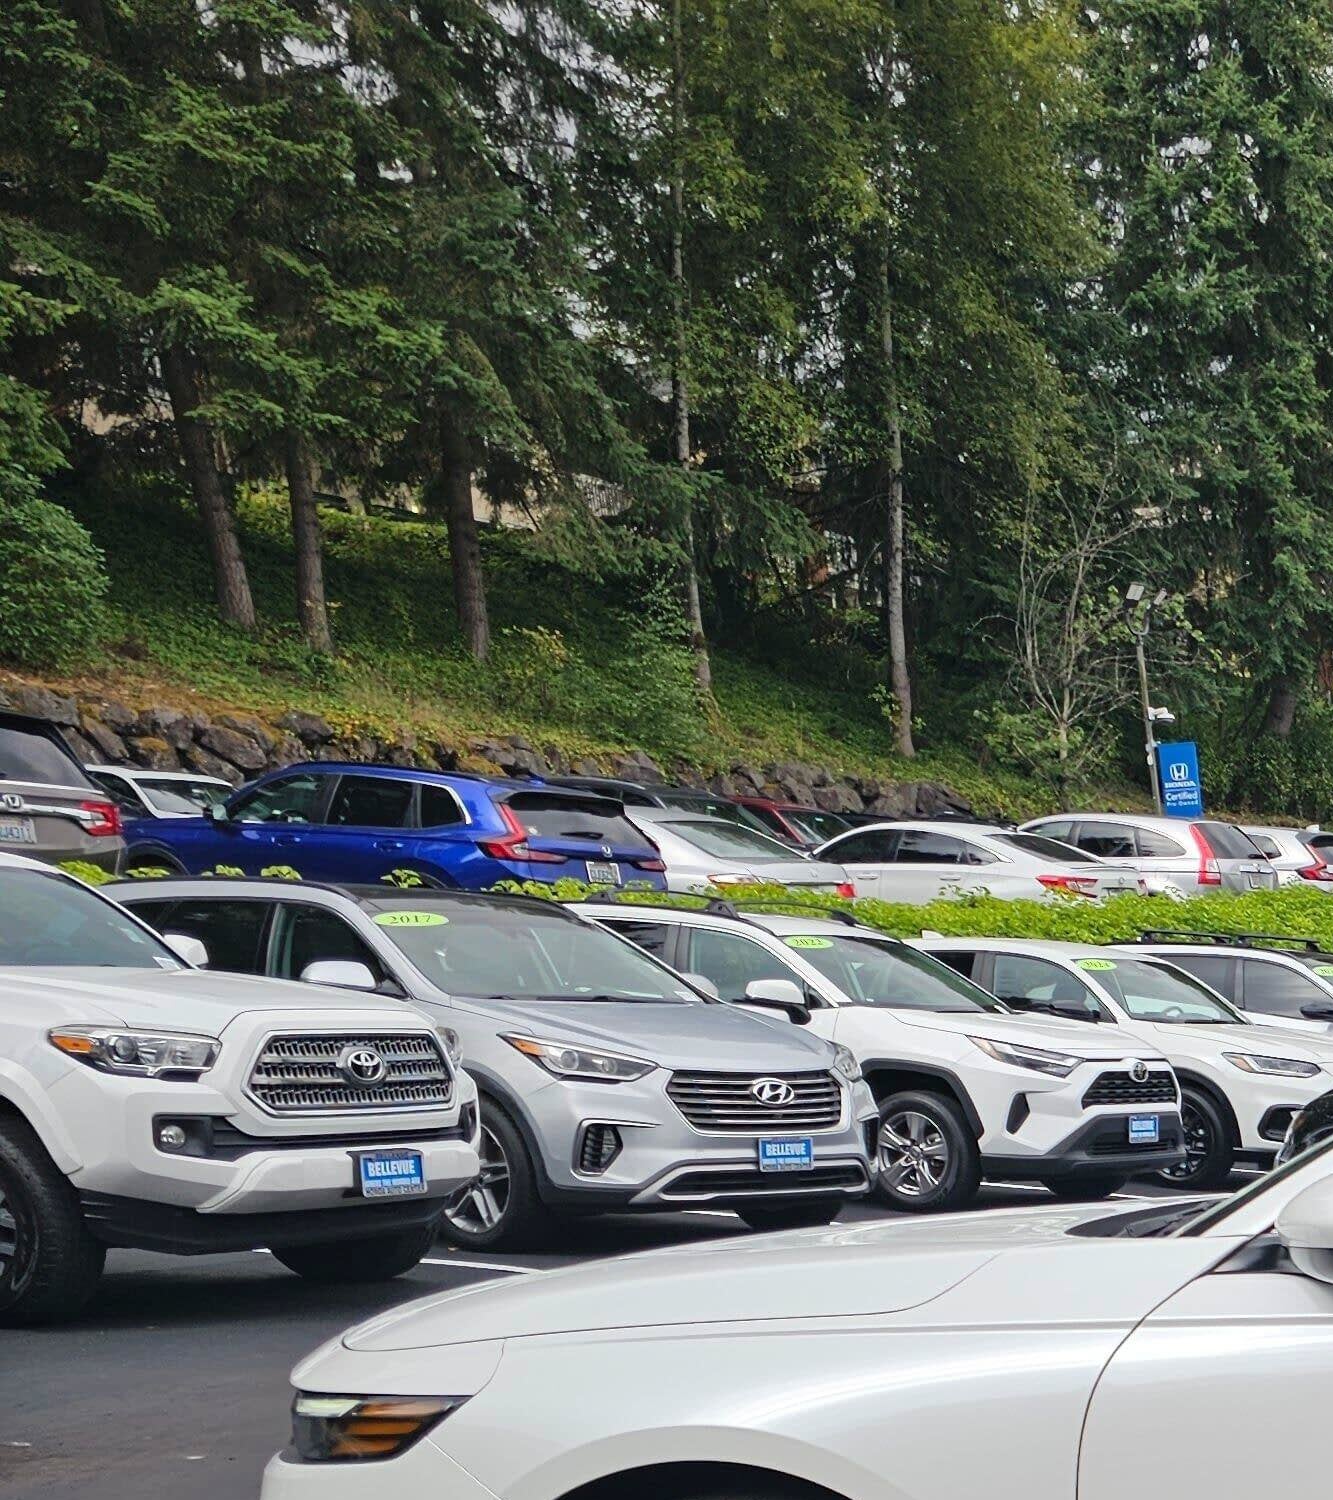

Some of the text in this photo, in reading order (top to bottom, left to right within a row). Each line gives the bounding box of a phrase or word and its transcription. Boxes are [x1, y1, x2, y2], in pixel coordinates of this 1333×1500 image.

[1164, 780, 1197, 788] HONDA
[1165, 791, 1198, 801] Certified
[389, 915, 431, 924] 2017
[765, 1143, 806, 1156] BELLEVUE
[367, 1159, 416, 1177] BELLEVUE
